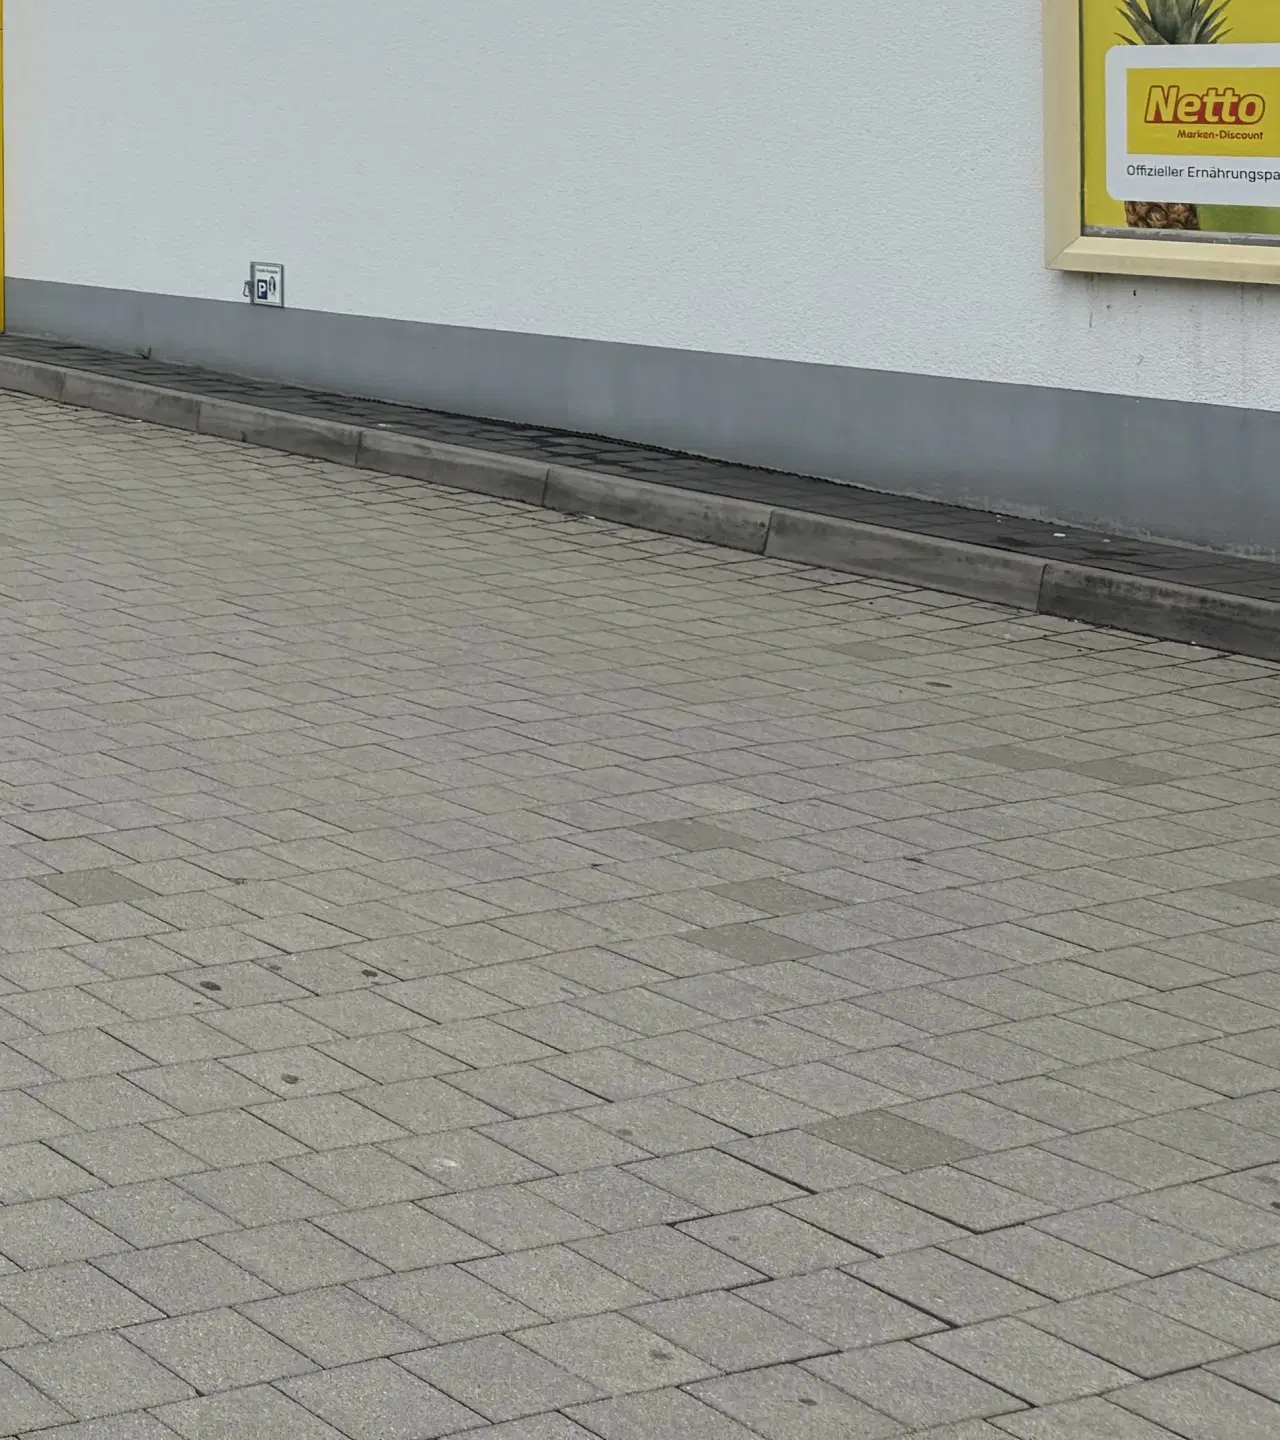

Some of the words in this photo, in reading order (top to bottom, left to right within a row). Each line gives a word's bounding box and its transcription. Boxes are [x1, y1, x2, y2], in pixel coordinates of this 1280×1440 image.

[1144, 85, 1266, 125] Netto
[1177, 129, 1264, 140] Marken-Discount
[1126, 164, 1184, 177] Offizieller
[1187, 166, 1280, 183] Ernährungspa
